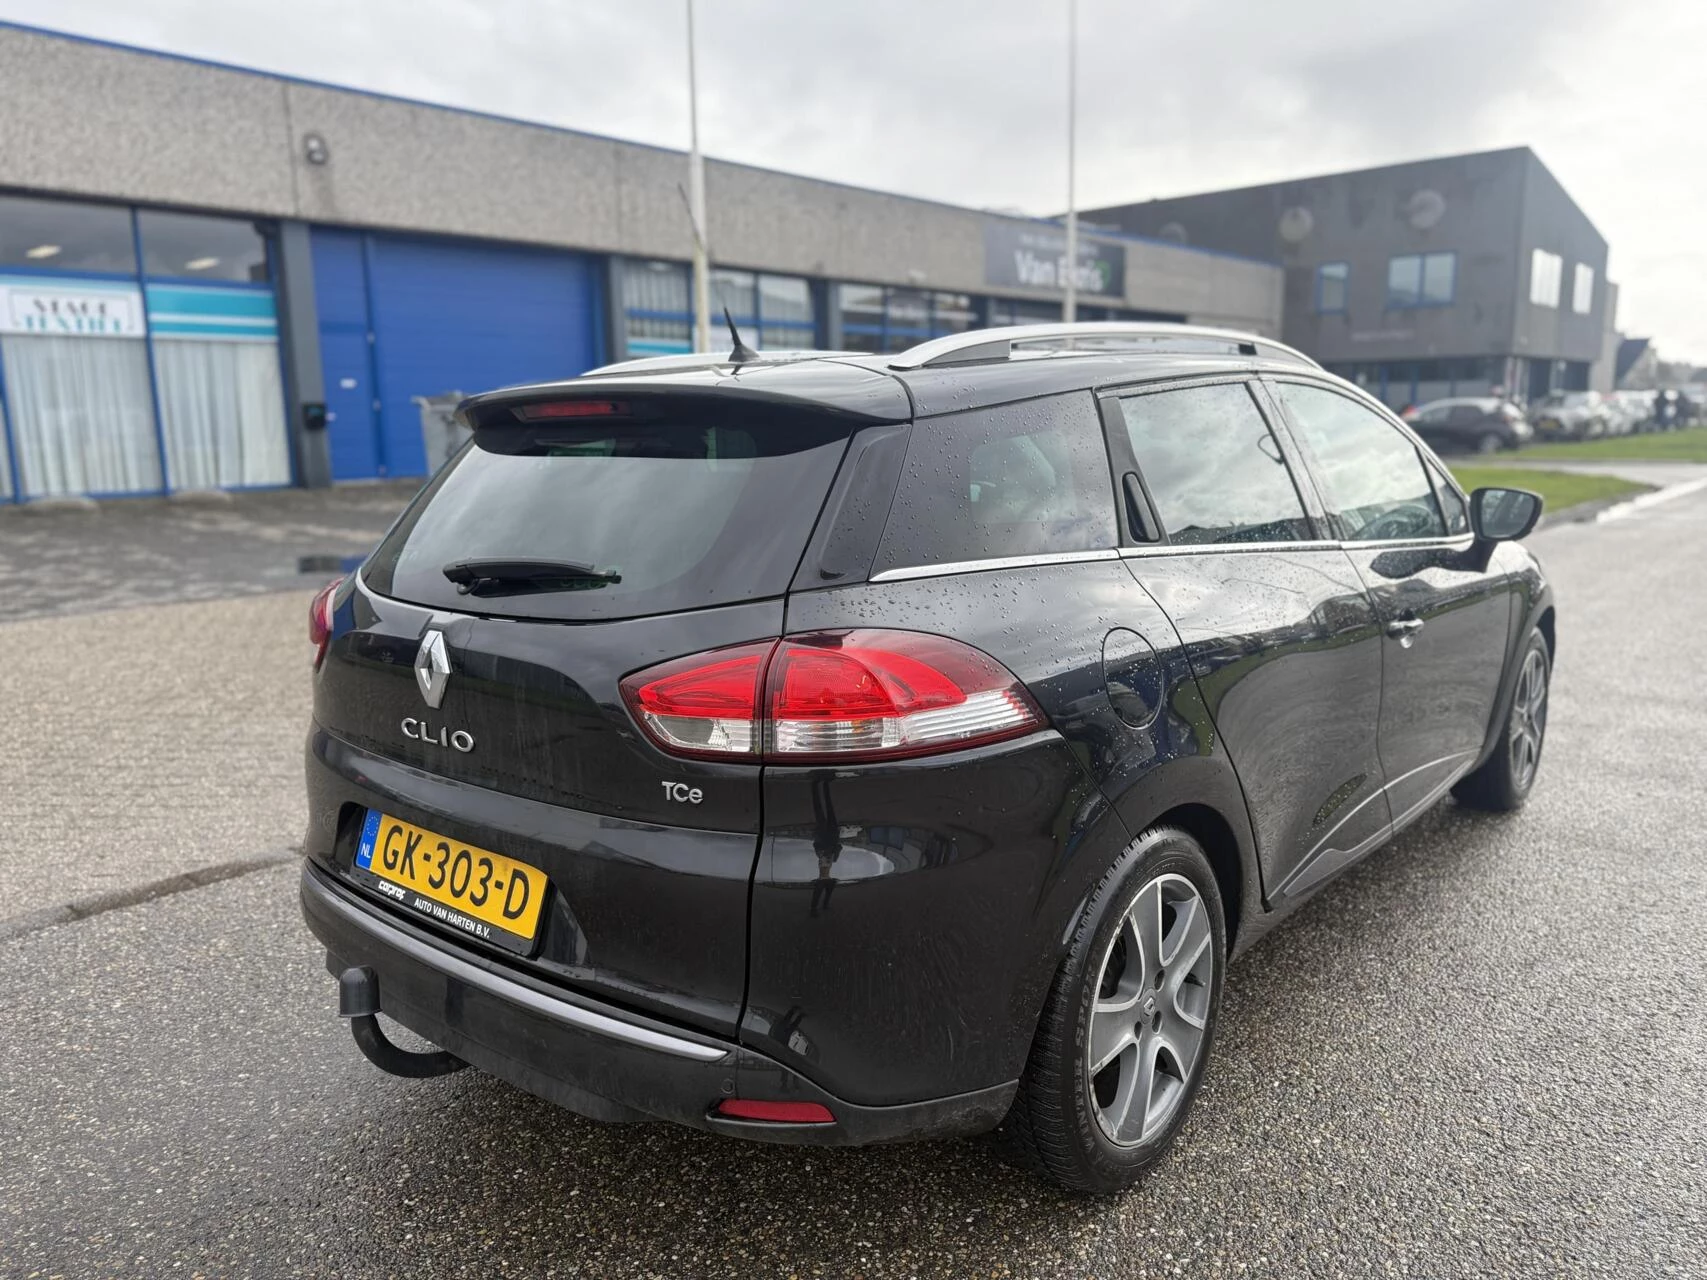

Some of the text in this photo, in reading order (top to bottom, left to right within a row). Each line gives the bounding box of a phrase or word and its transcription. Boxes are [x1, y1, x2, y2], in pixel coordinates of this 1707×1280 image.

[400, 717, 475, 753] CLIO
[661, 781, 703, 804] TCe
[361, 843, 371, 859] NL
[383, 825, 530, 920] GK-303-D
[414, 898, 490, 938] AUTO VAN HARTEN B.V.
